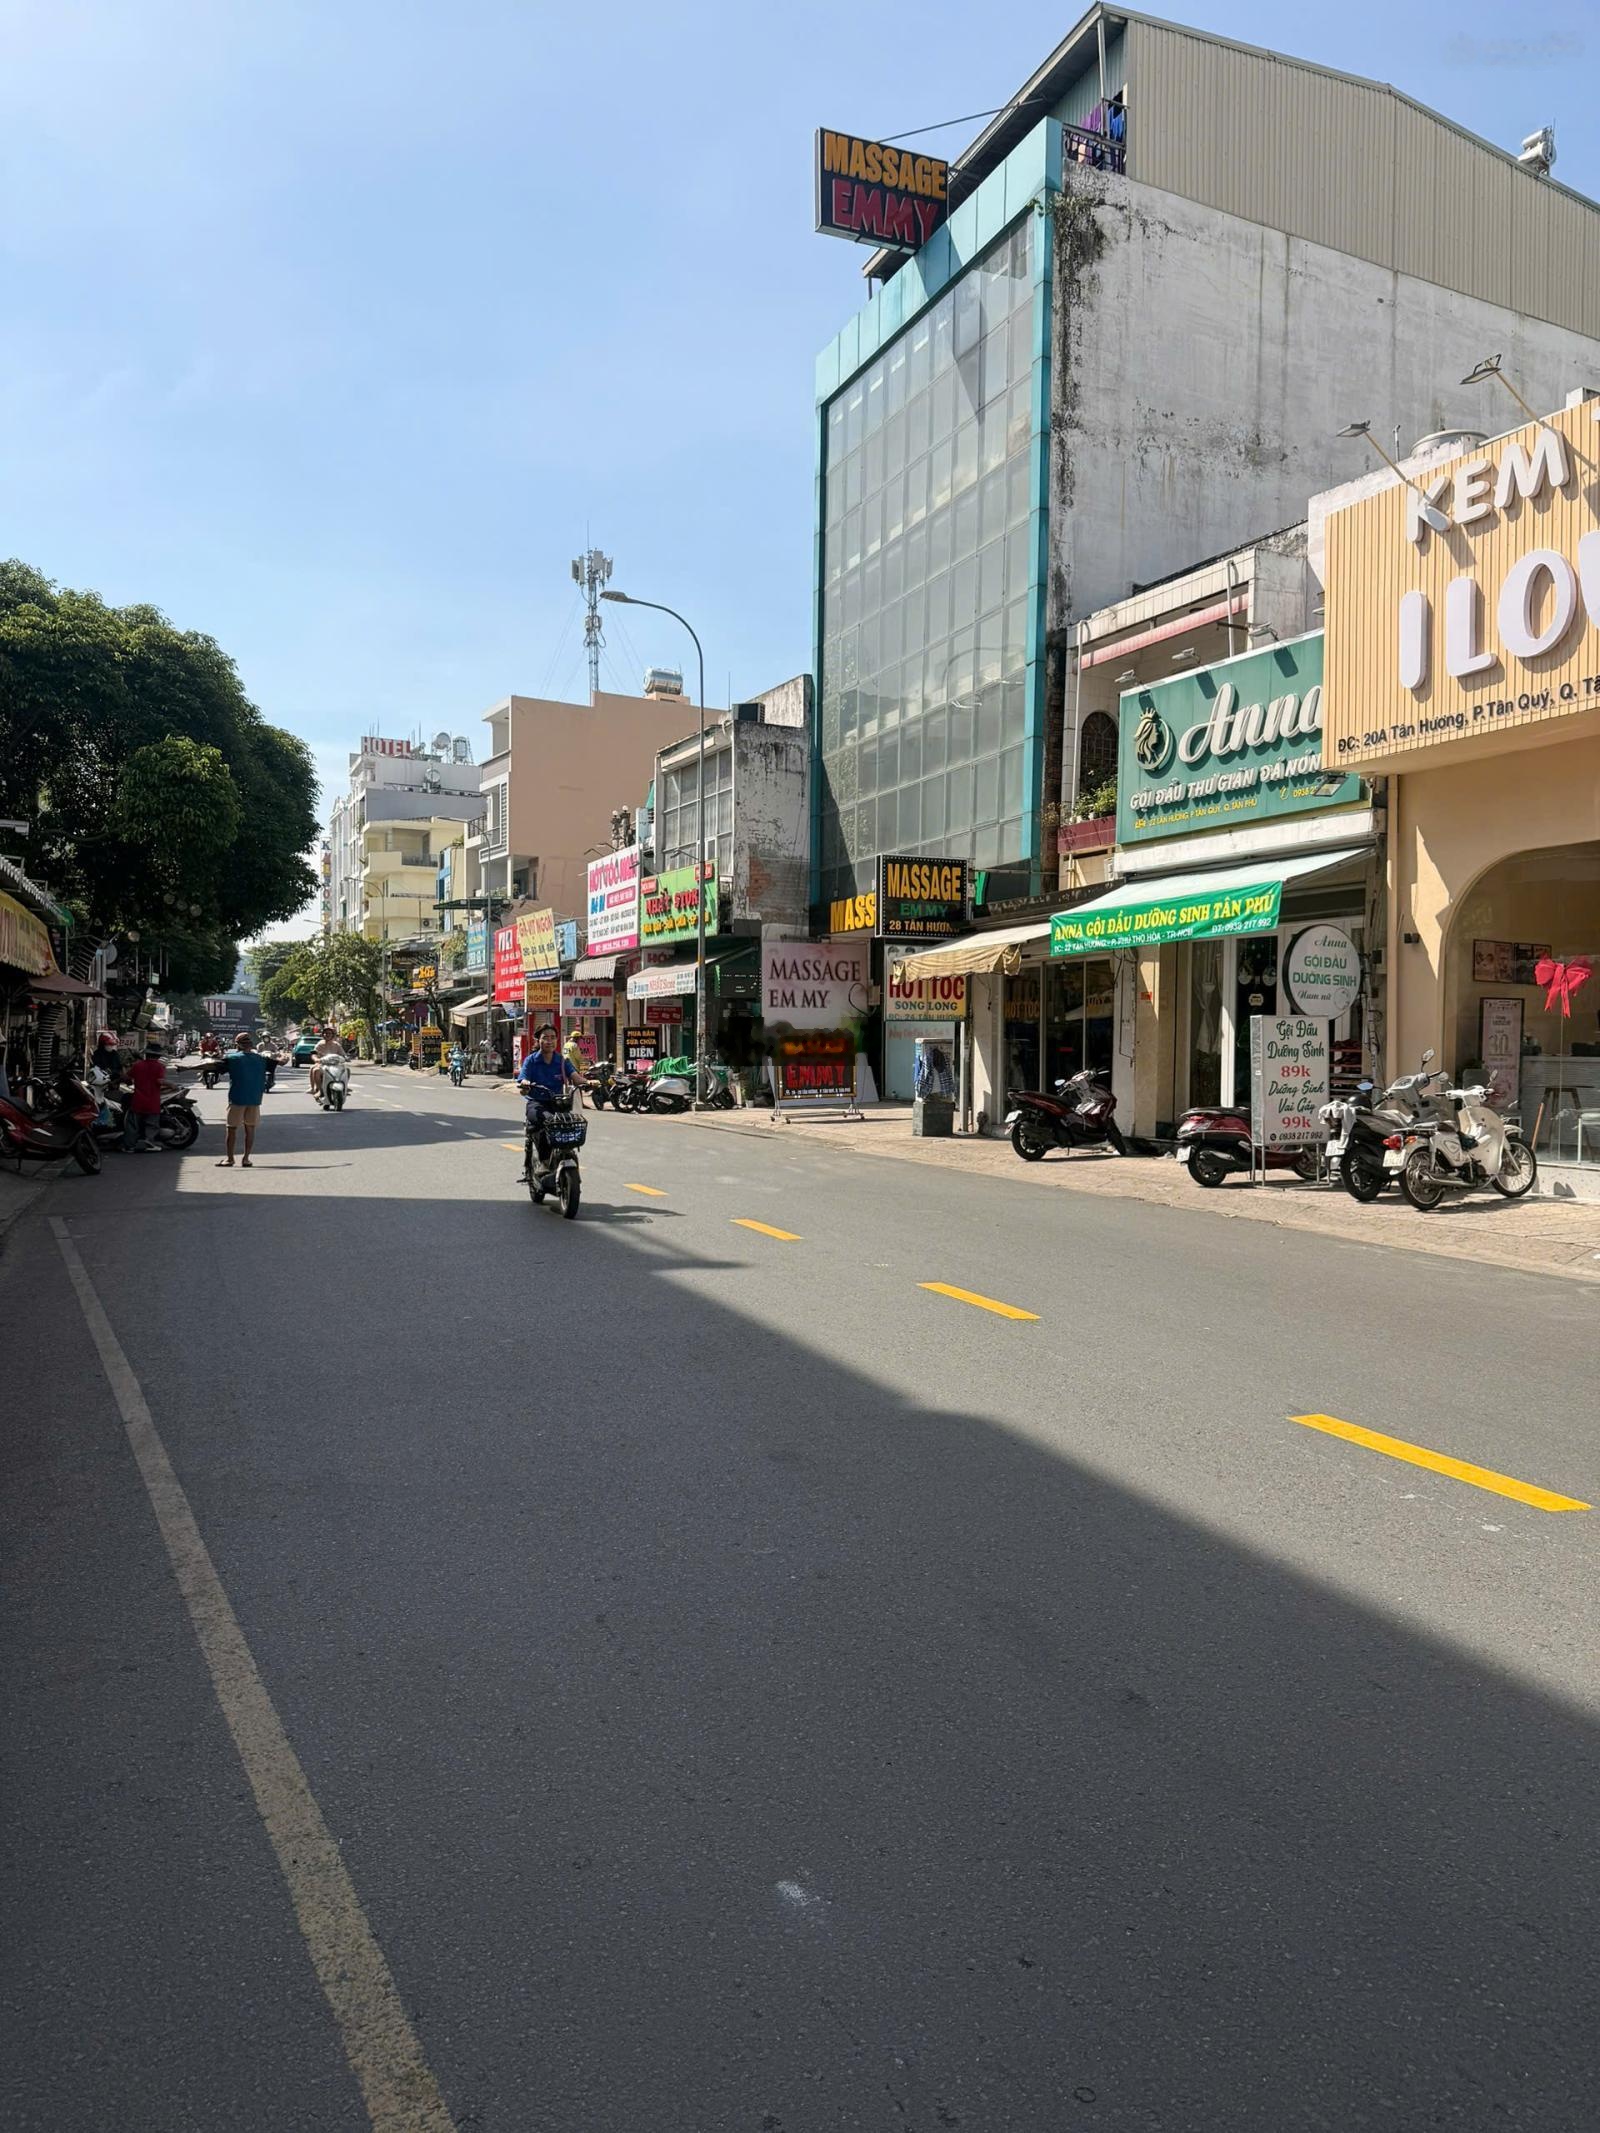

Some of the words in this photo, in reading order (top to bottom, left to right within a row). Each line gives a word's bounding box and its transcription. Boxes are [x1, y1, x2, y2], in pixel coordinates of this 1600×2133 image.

[824, 131, 946, 199] MASSAGE
[832, 178, 938, 245] EMMY
[1406, 428, 1569, 543] KEM
[1363, 732, 1387, 747] 20A
[1391, 725, 1415, 740] Tân
[362, 737, 410, 755] HOTEL
[887, 863, 962, 901] MASSAGE
[1054, 923, 1083, 940] ANNA
[1179, 904, 1211, 924] SINH
[1213, 896, 1242, 919] TÂN
[1244, 888, 1275, 915] PHÚ
[889, 920, 902, 931] 28
[904, 919, 924, 931] TÂN
[926, 919, 960, 933] HƯƠN
[1314, 935, 1348, 948] Anna
[769, 958, 861, 982] MASSAGE
[1333, 974, 1357, 987] SINH
[895, 1001, 925, 1011] SONG
[928, 1001, 958, 1011] LONG
[1276, 1020, 1294, 1040] Gội
[629, 1047, 654, 1060] ĐIỆN
[1302, 1040, 1325, 1058] Sinh
[786, 1063, 845, 1088] EMMY
[1281, 1065, 1311, 1078] 89k
[1302, 1080, 1325, 1095] Sinh
[1278, 1098, 1294, 1114] Vai
[1296, 1097, 1316, 1114] Gáy
[1282, 1116, 1311, 1129] 99k
[1297, 1132, 1310, 1140] 217
